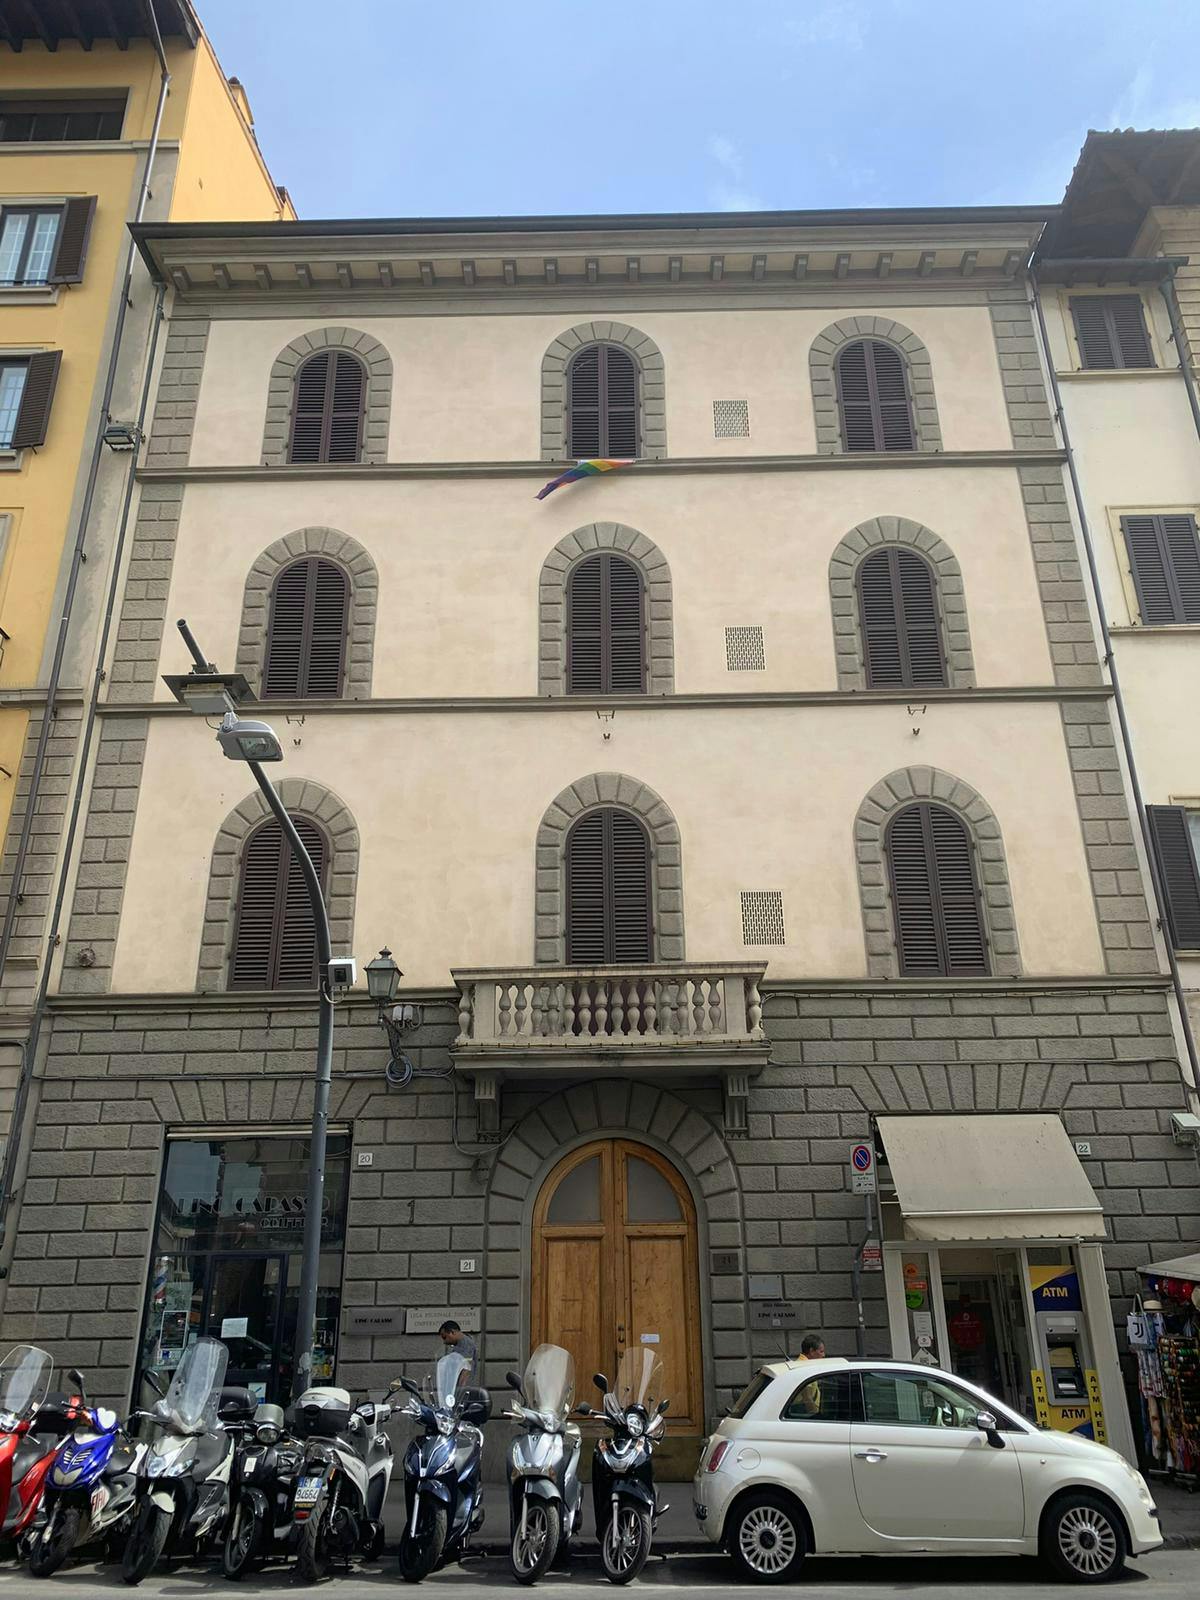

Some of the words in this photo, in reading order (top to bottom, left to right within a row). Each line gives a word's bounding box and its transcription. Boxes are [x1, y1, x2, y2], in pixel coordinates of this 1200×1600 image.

[1078, 1144, 1089, 1153] 22
[360, 1154, 371, 1164] 20
[463, 1261, 473, 1270] 21
[1042, 1287, 1068, 1298] ATM
[1035, 1375, 1045, 1403] ATM
[1090, 1375, 1100, 1403] ATM
[1061, 1408, 1086, 1419] ATM
